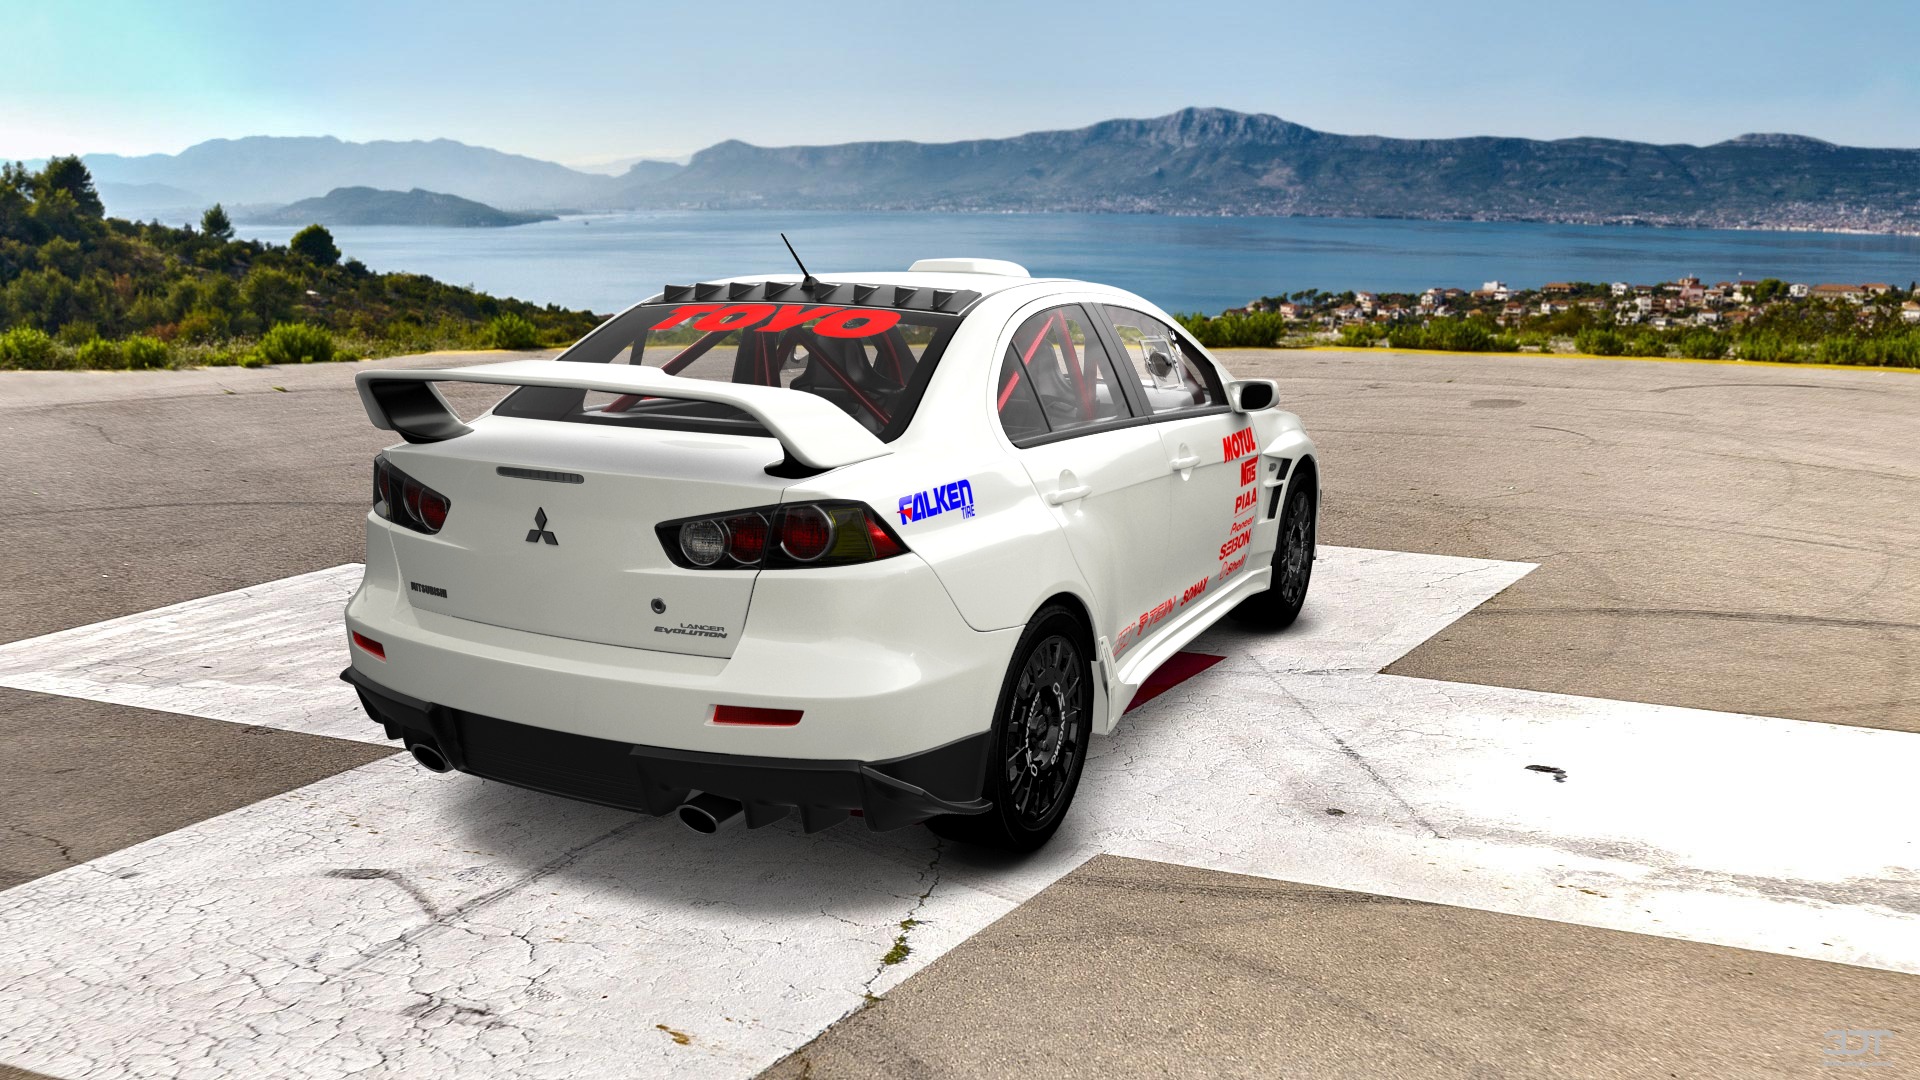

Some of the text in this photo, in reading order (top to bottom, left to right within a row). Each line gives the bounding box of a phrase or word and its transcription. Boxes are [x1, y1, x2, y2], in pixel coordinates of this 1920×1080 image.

[649, 304, 902, 339] TOYO
[1222, 426, 1256, 463] MOTUL
[897, 479, 974, 525] FALKEN
[961, 504, 976, 520] TIRE
[1235, 487, 1257, 514] PIAA
[653, 625, 728, 639] EVOLUTION
[680, 622, 725, 632] LANCER
